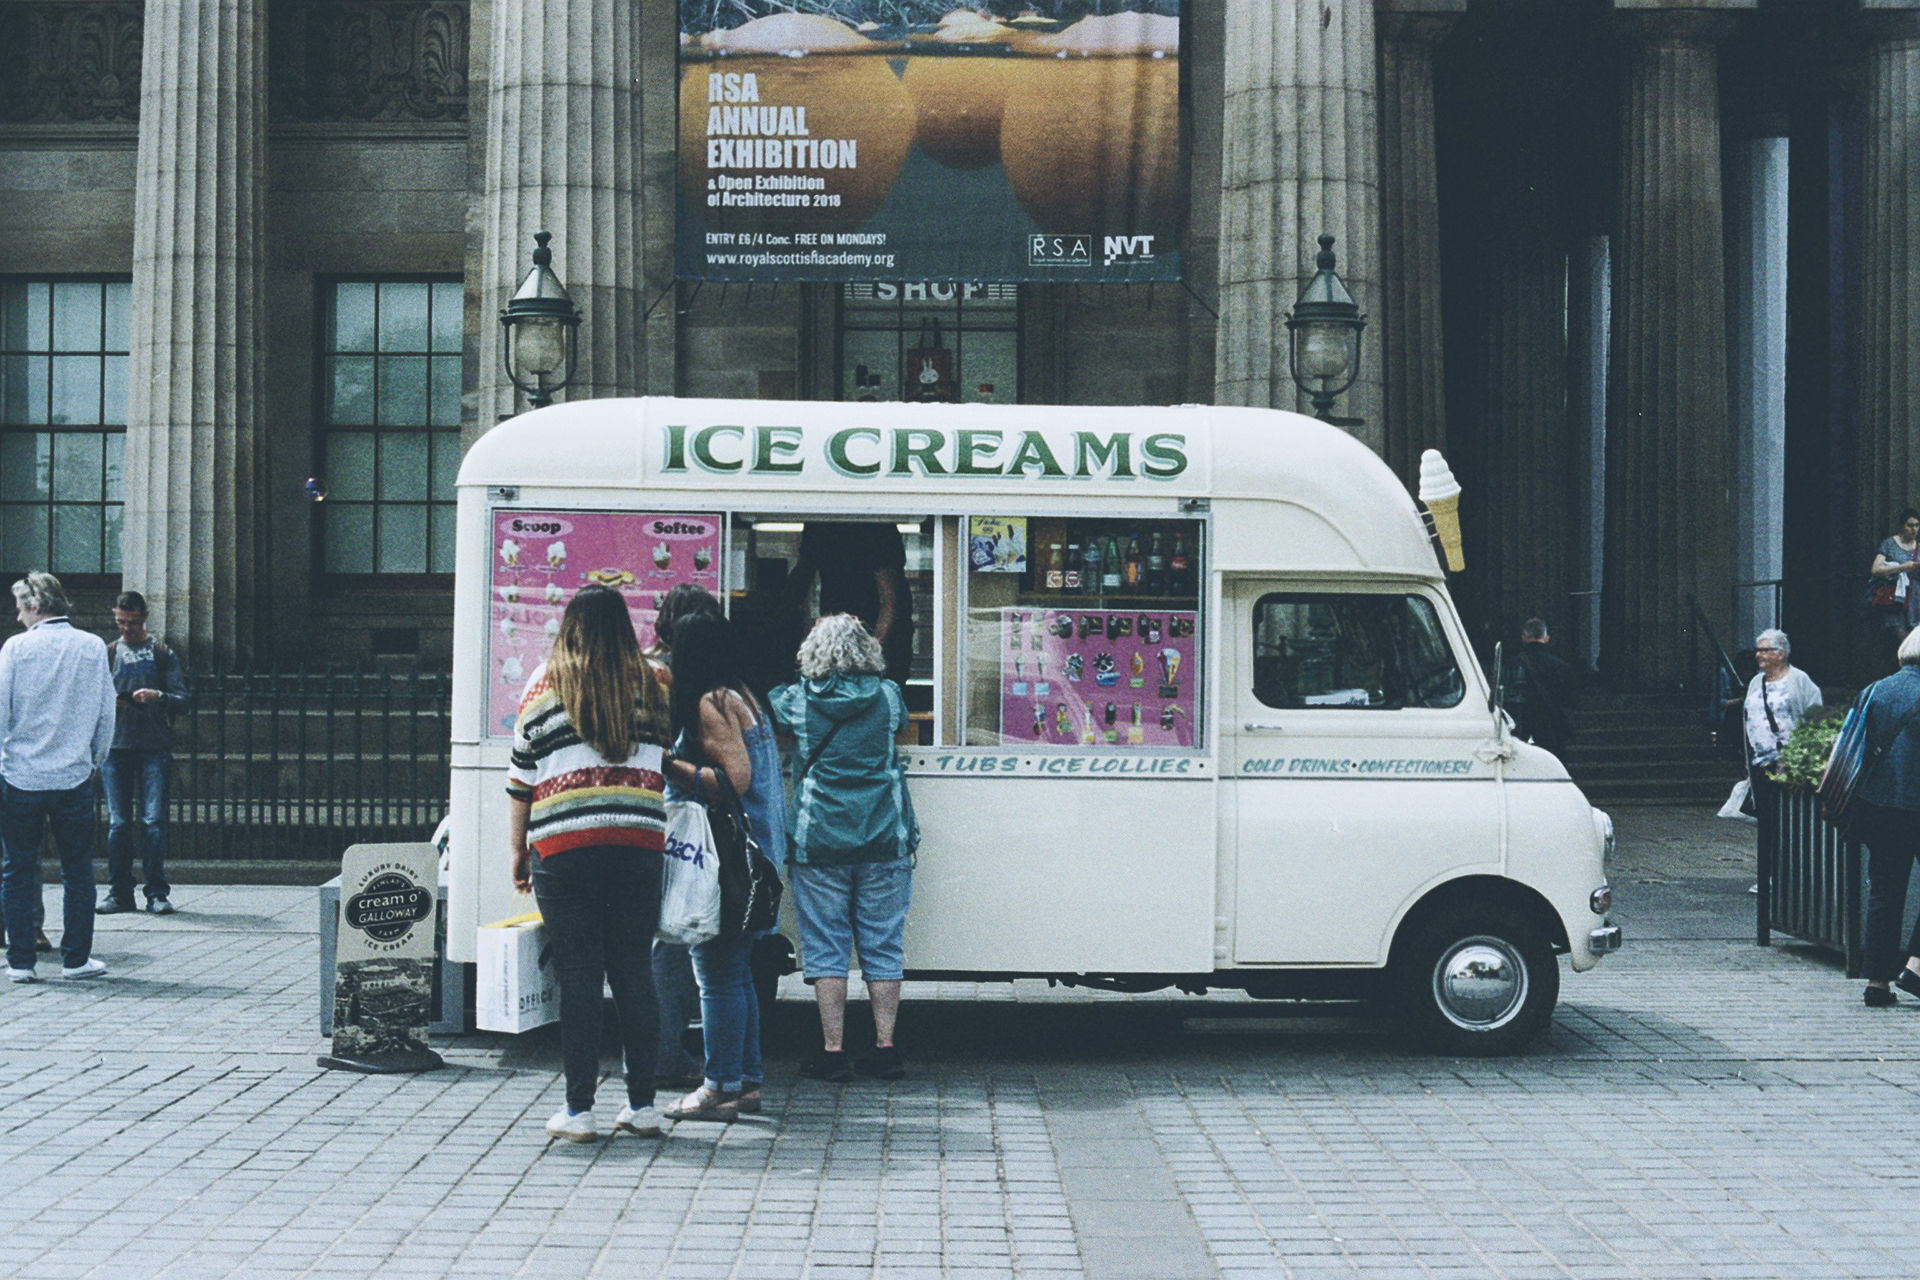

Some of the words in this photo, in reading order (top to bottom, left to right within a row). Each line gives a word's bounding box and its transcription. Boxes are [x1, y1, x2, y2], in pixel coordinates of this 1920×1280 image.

[708, 73, 760, 103] RSA
[706, 106, 810, 136] ANNUAL
[707, 139, 857, 169] EXHIBITION
[708, 178, 716, 190] &
[718, 174, 753, 192] Open
[755, 175, 825, 190] Exhibition
[707, 192, 721, 207] of
[722, 191, 811, 207] Architecture
[813, 194, 841, 207] 2018
[706, 233, 736, 245] ENTRY
[766, 234, 791, 245] Conc.
[795, 234, 818, 245] FREE
[820, 234, 834, 245] ON
[836, 234, 887, 245] MONDAYS!
[1033, 238, 1087, 257] RSA
[1104, 236, 1155, 255] NVT
[877, 282, 983, 301] SHOP
[660, 425, 805, 475] ICE
[823, 428, 1188, 482] CREAMS
[512, 520, 561, 534] Scoop
[653, 521, 706, 536] Softee
[936, 755, 1018, 771] TUBS
[1242, 758, 1286, 773] COLD
[1288, 758, 1350, 774] DRINKS
[1357, 759, 1475, 775] CONFECTIONERY
[358, 893, 405, 909] cream
[358, 906, 418, 923] GALLOWAY
